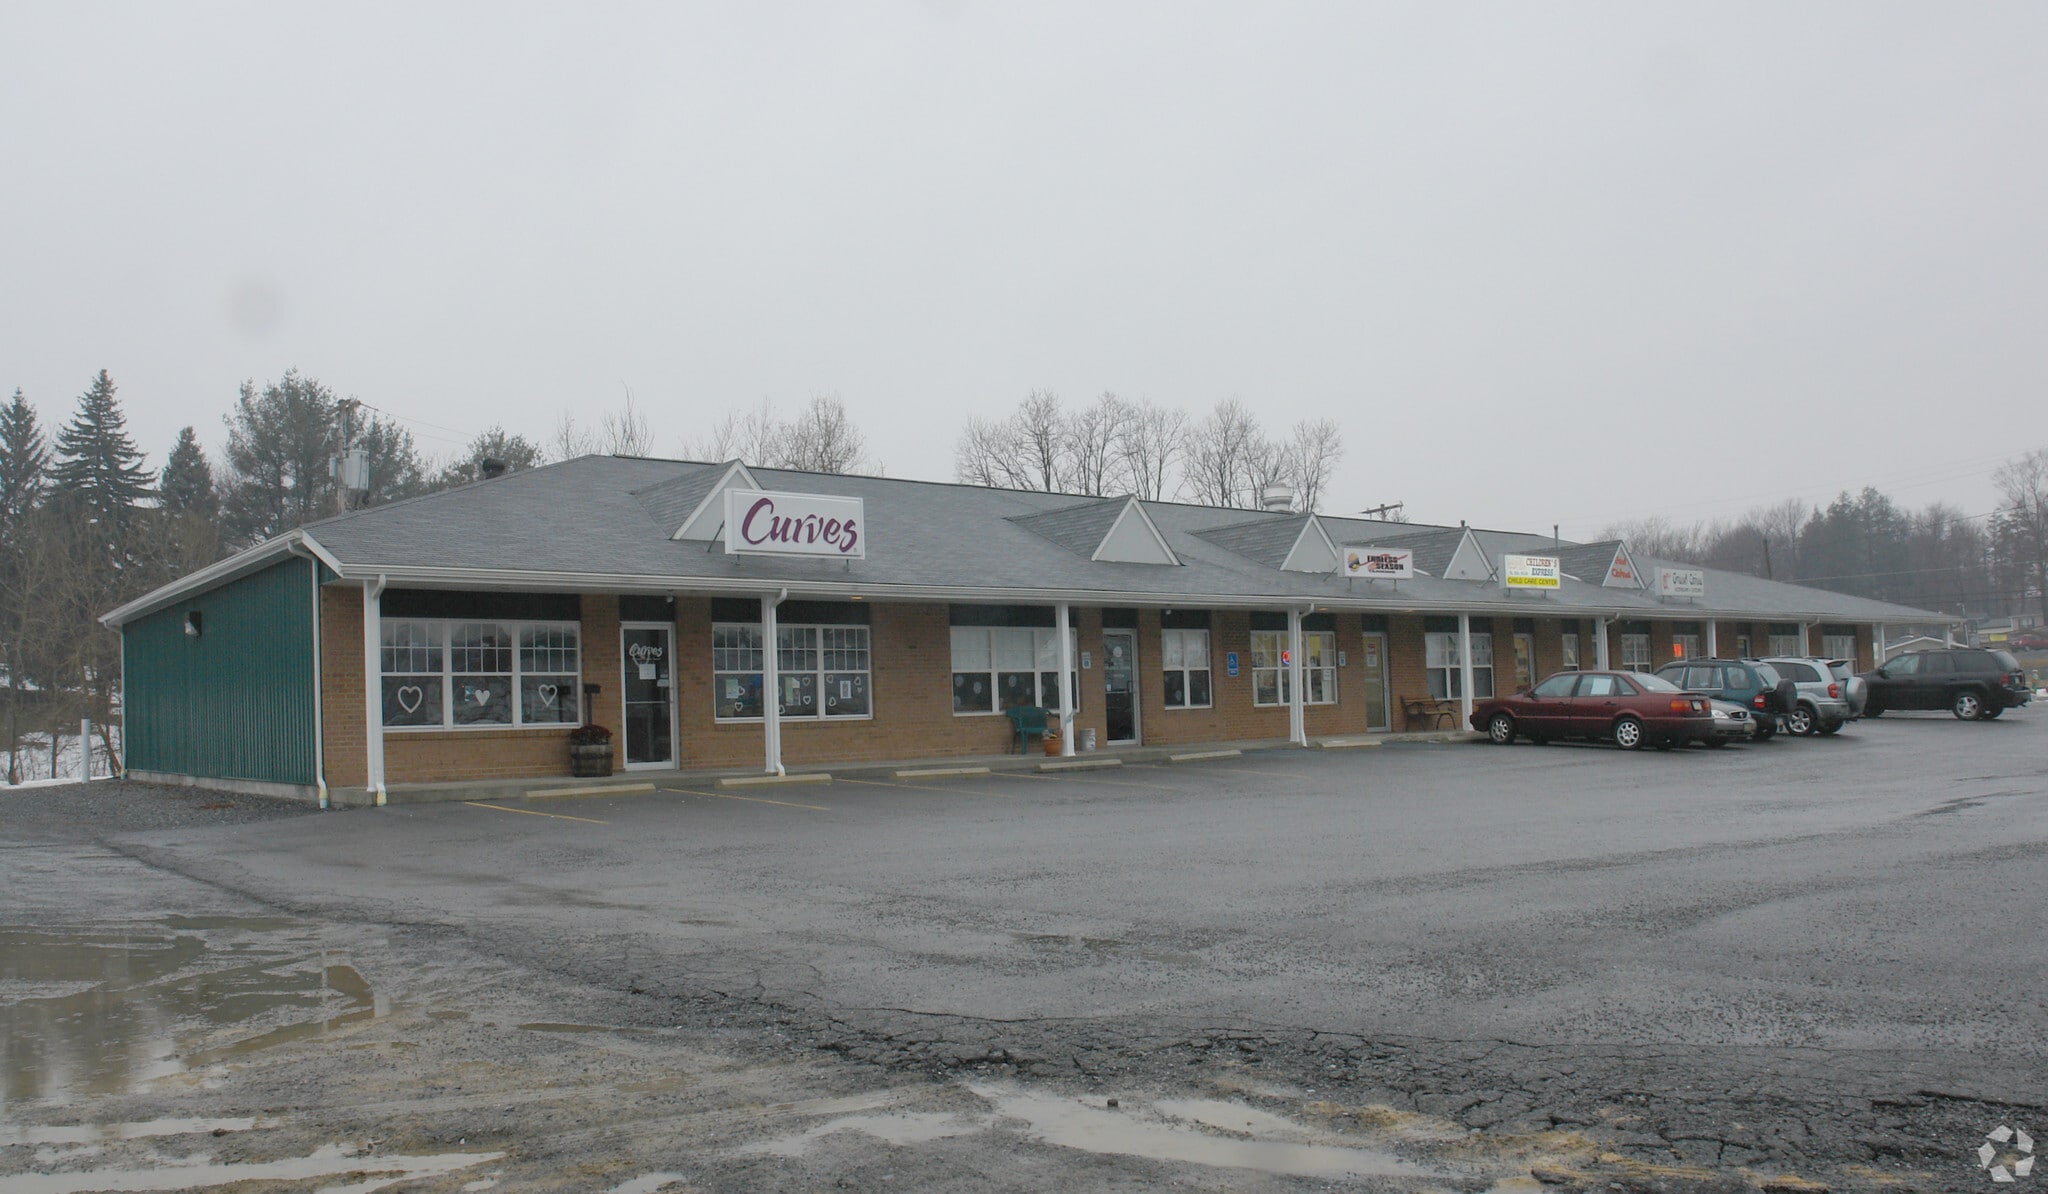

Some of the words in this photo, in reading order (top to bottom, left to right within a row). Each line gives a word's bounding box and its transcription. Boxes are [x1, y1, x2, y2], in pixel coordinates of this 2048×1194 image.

[741, 498, 858, 553] Curves
[1532, 568, 1554, 576] EXPRESS
[1508, 576, 1523, 584] CHILD
[1524, 577, 1537, 585] CARE
[1538, 578, 1558, 586] CENTER
